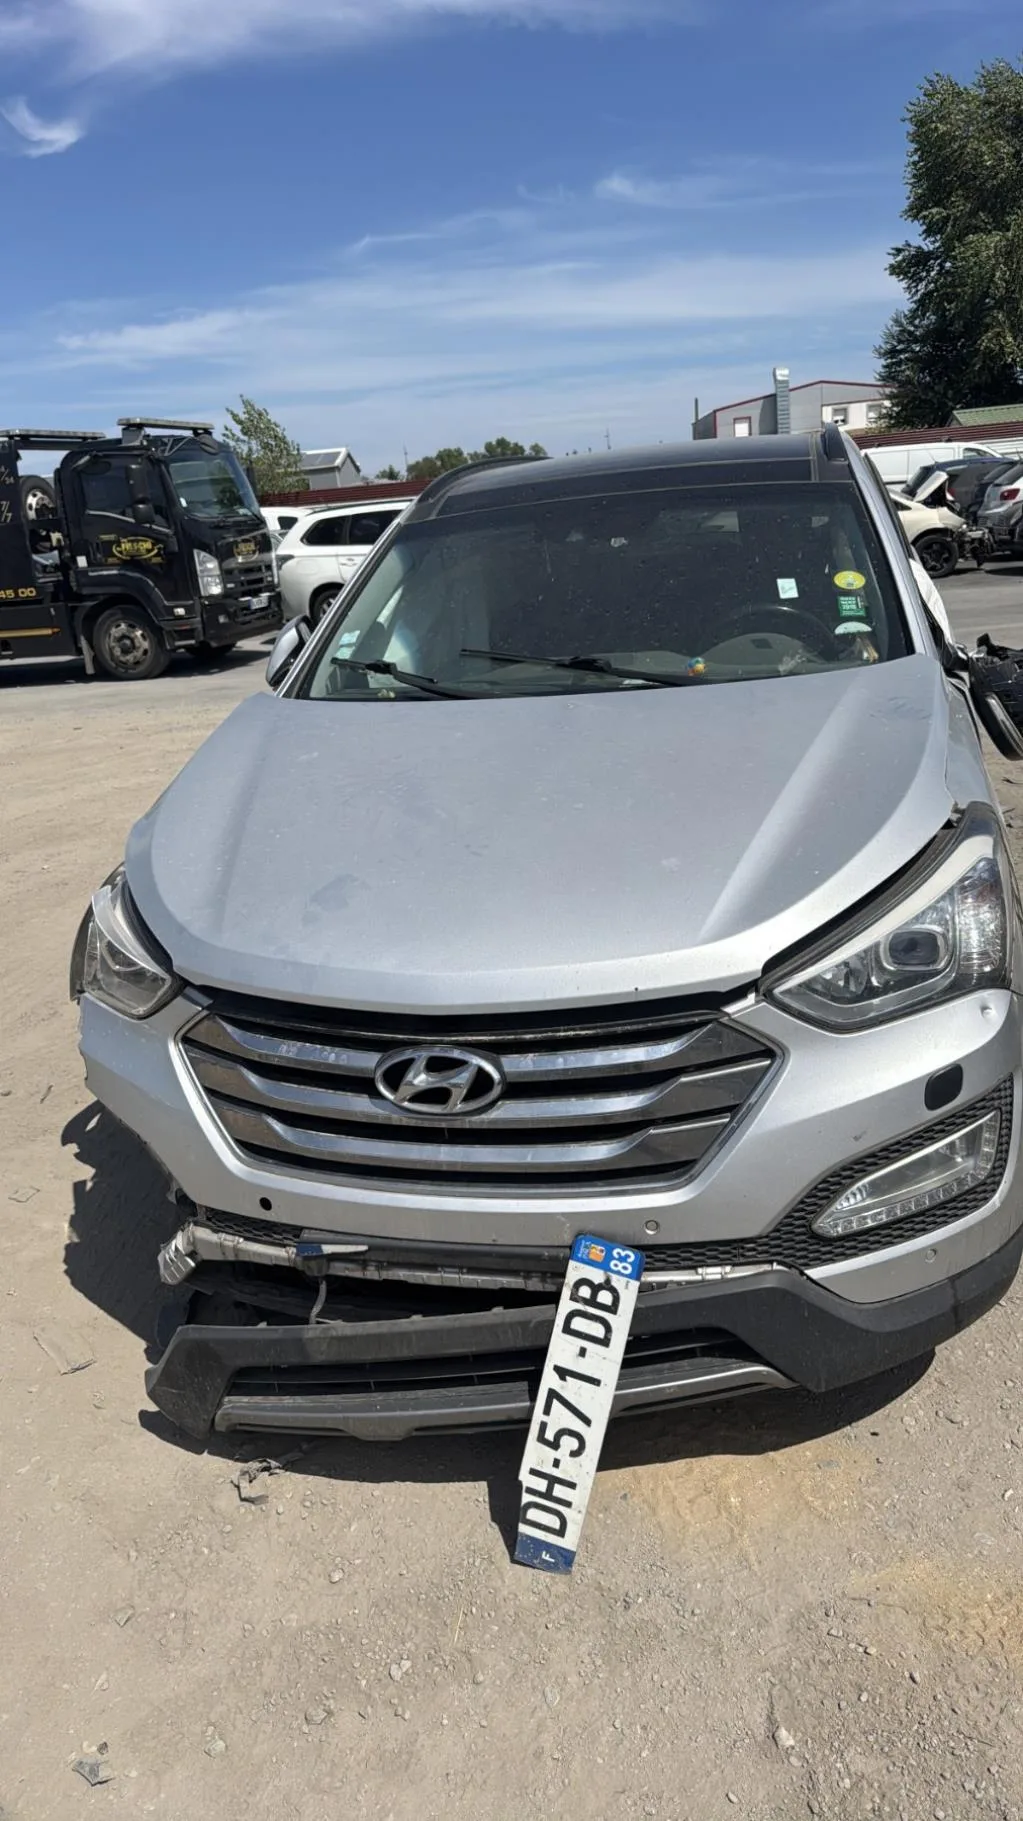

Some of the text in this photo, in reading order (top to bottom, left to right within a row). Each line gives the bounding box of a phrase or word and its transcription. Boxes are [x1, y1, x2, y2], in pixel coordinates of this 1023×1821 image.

[18, 587, 36, 598] 00
[609, 1247, 635, 1275] 83
[519, 1277, 621, 1539] DH-571-DB
[541, 1551, 555, 1562] F
